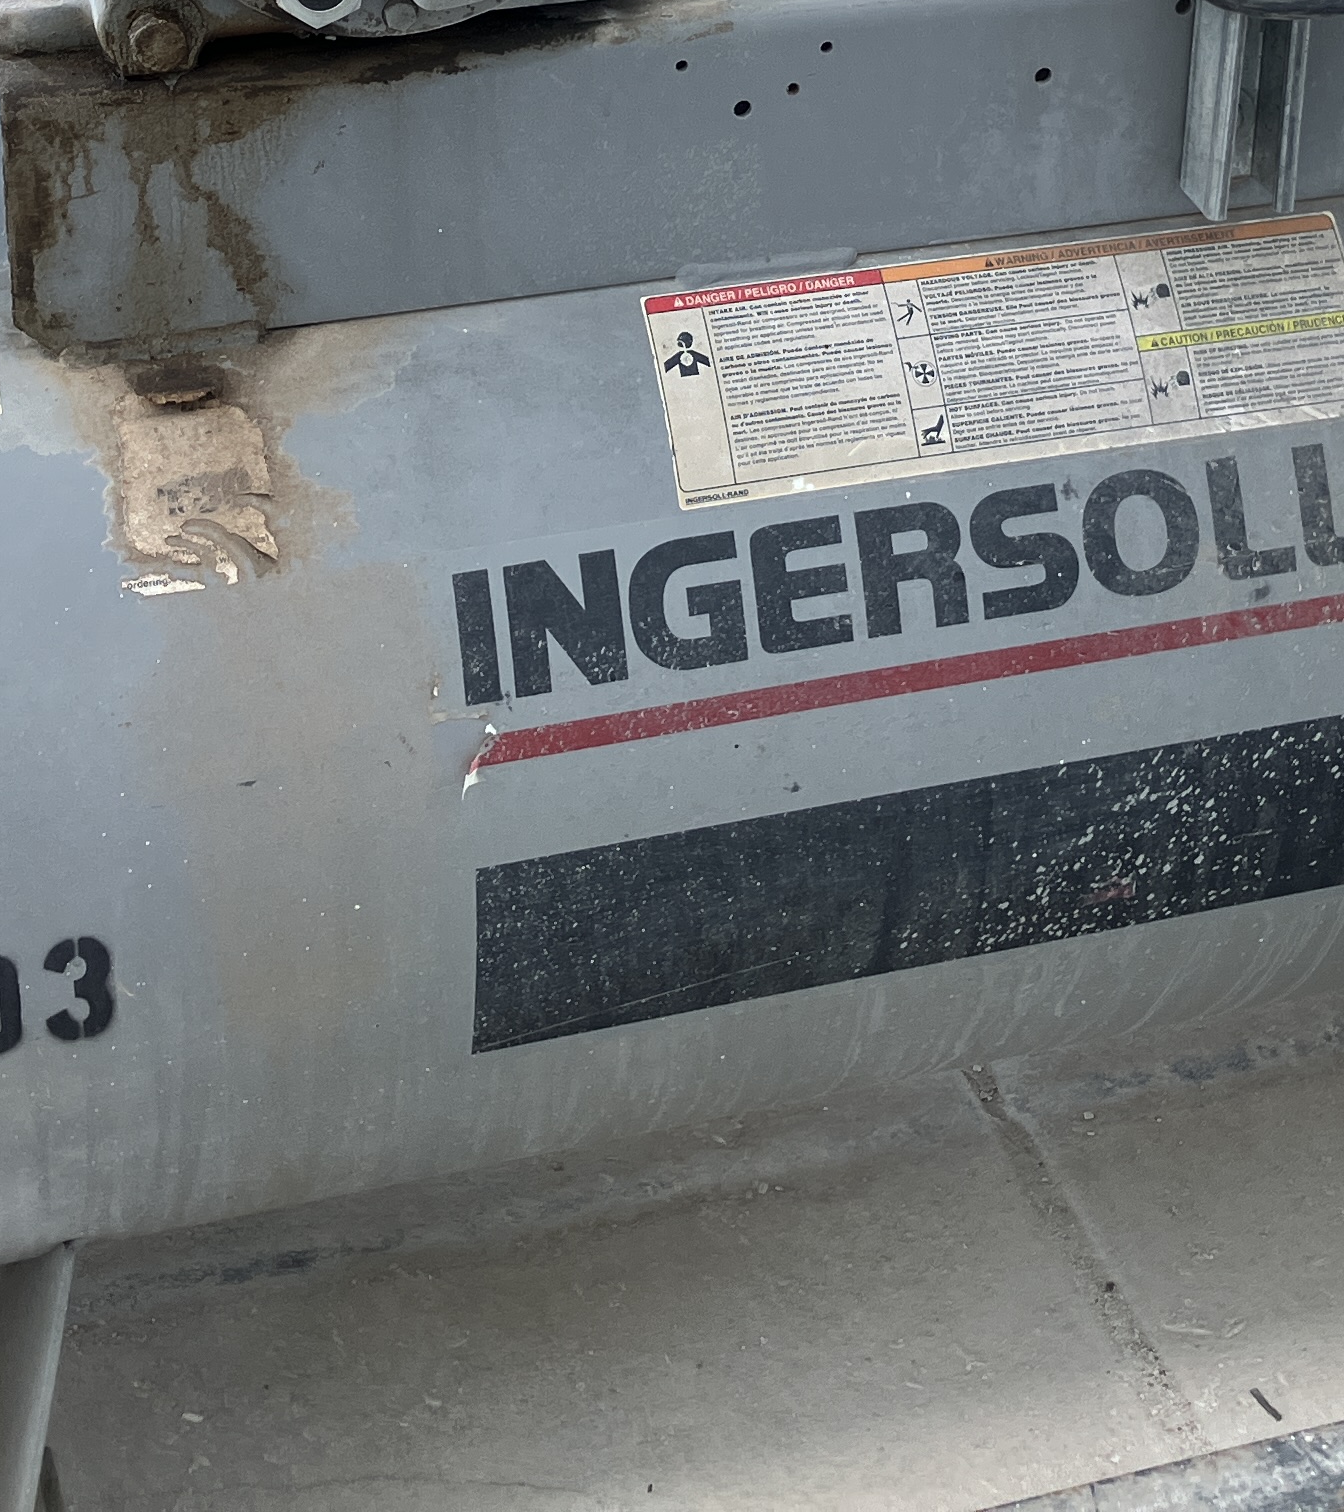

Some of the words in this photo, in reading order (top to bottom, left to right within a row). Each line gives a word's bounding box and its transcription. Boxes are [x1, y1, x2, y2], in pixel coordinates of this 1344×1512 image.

[994, 250, 1050, 267] WARNING
[1057, 239, 1136, 259] ADVERTENCIA
[1145, 228, 1236, 249] AVERTISSEMENT
[686, 290, 737, 307] DANGER
[744, 283, 798, 299] PELIGRO
[805, 276, 856, 291] DANGER
[1160, 332, 1209, 347] CAUTION
[1216, 321, 1286, 340] PRECAUCIÓN
[685, 488, 749, 505] INGERSOLL-RAND
